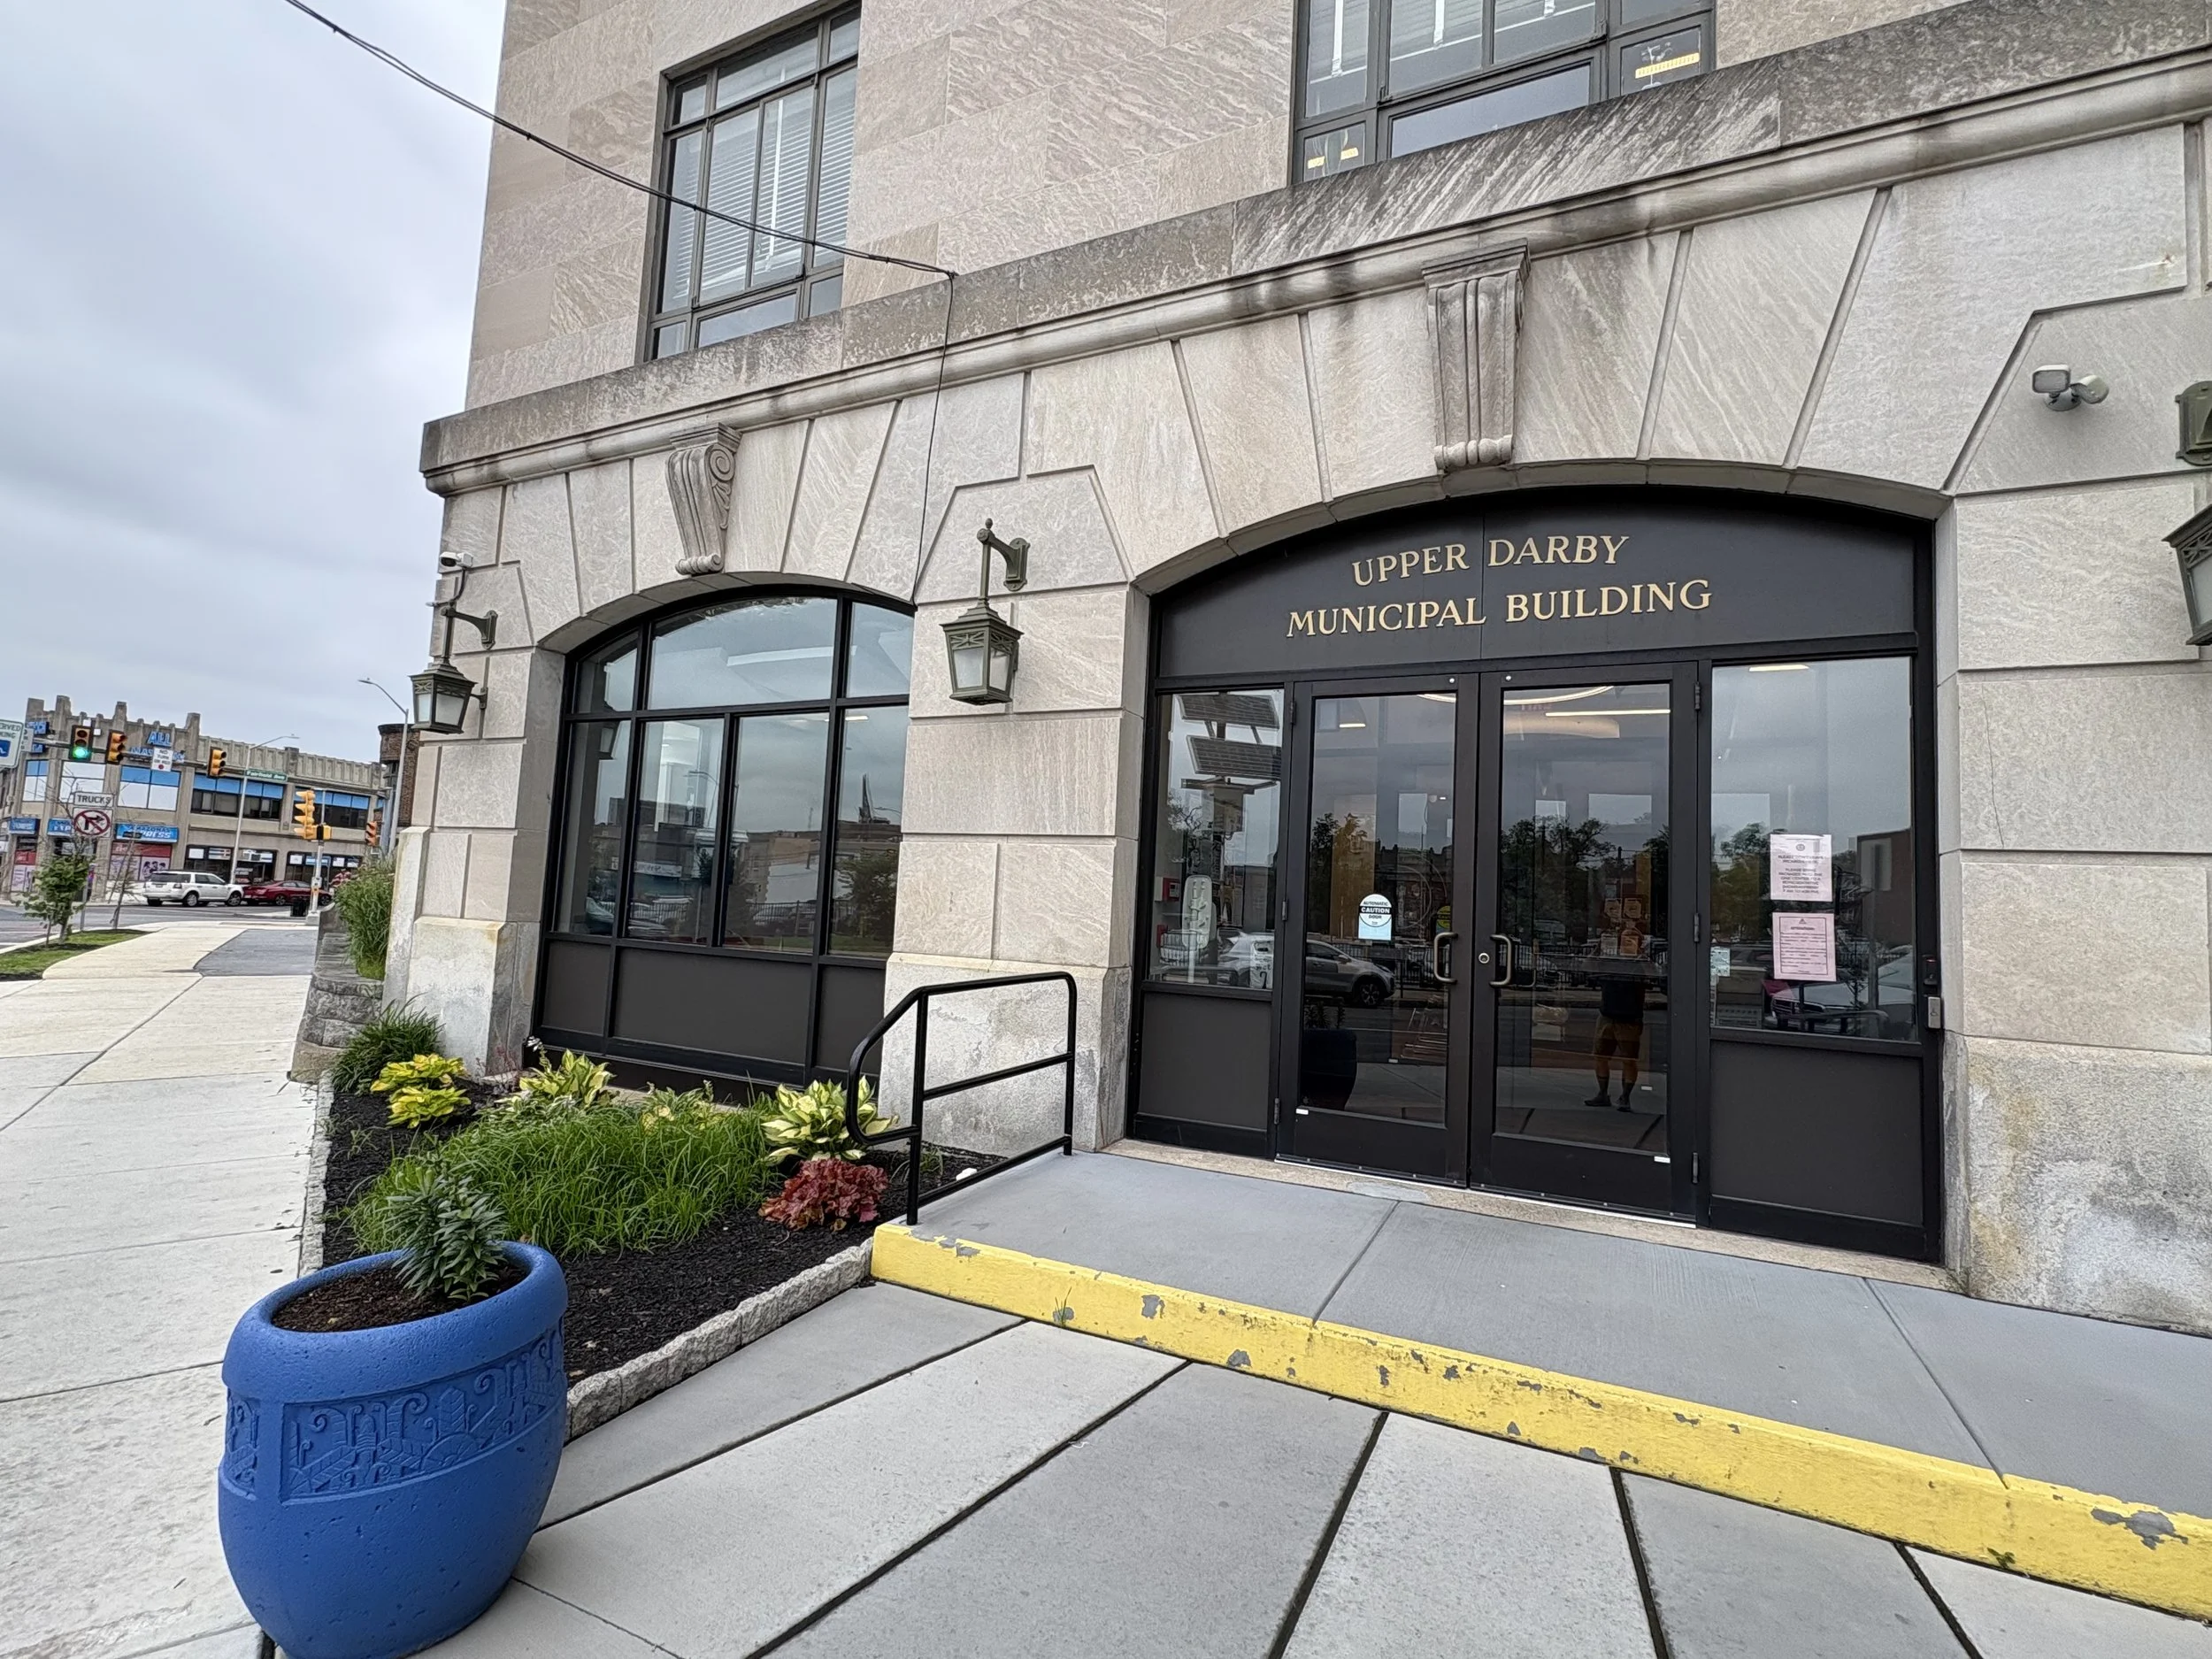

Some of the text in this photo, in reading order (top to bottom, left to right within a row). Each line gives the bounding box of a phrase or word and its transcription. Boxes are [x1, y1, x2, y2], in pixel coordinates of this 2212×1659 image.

[1352, 535, 1629, 586] UPPER DARBY
[1286, 580, 1712, 638] MUNICIPAL BUILDING
[78, 795, 111, 804] TRUCKS
